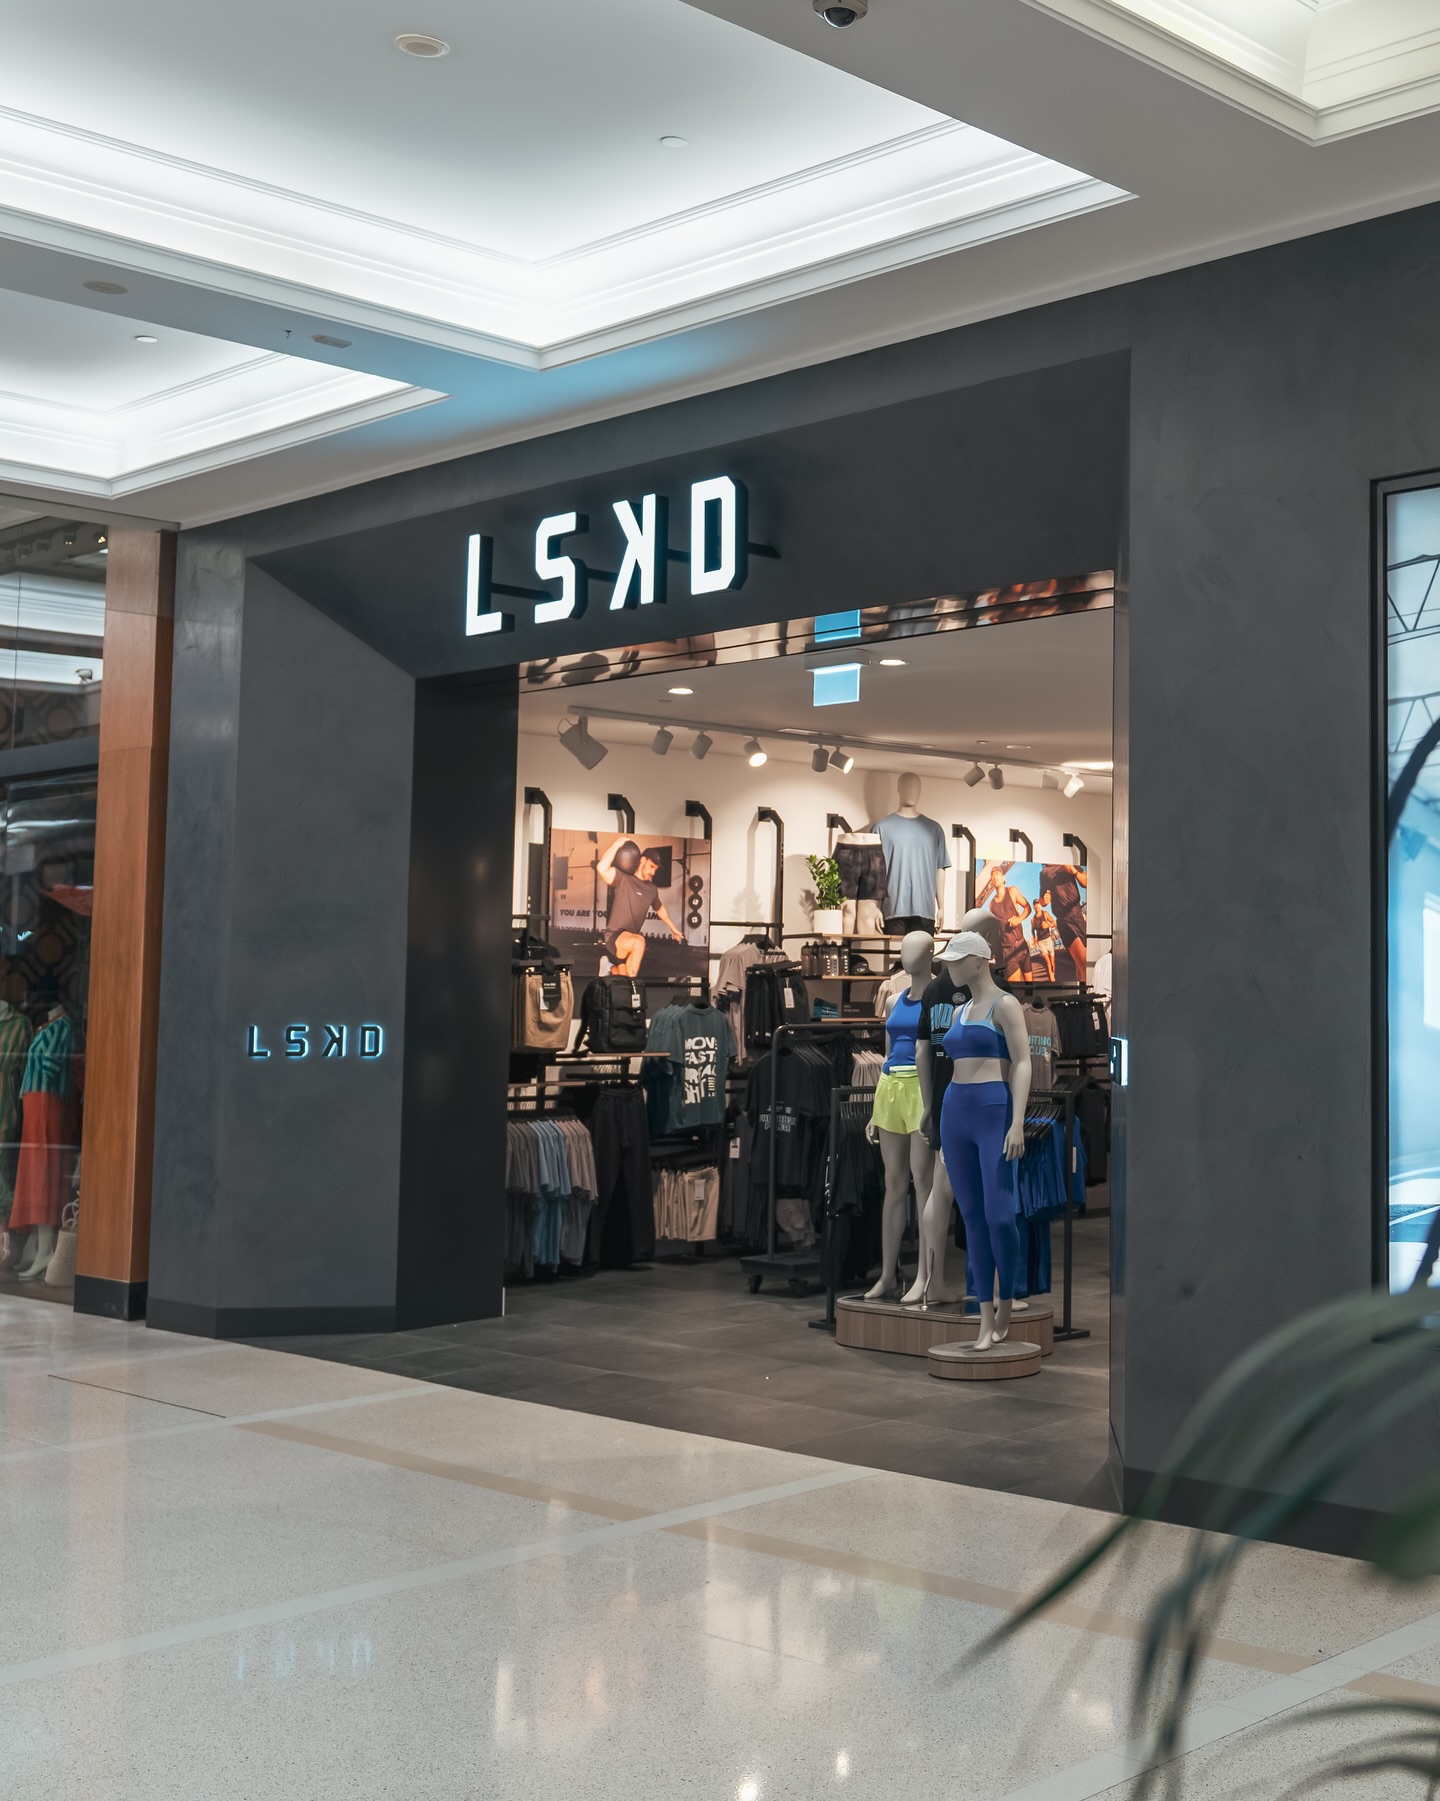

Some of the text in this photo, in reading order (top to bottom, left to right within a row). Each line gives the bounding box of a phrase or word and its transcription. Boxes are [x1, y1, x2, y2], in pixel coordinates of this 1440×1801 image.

[464, 475, 740, 637] LSKD
[559, 908, 575, 917] YOU
[575, 909, 591, 918] ARE
[247, 1024, 385, 1058] LSKD
